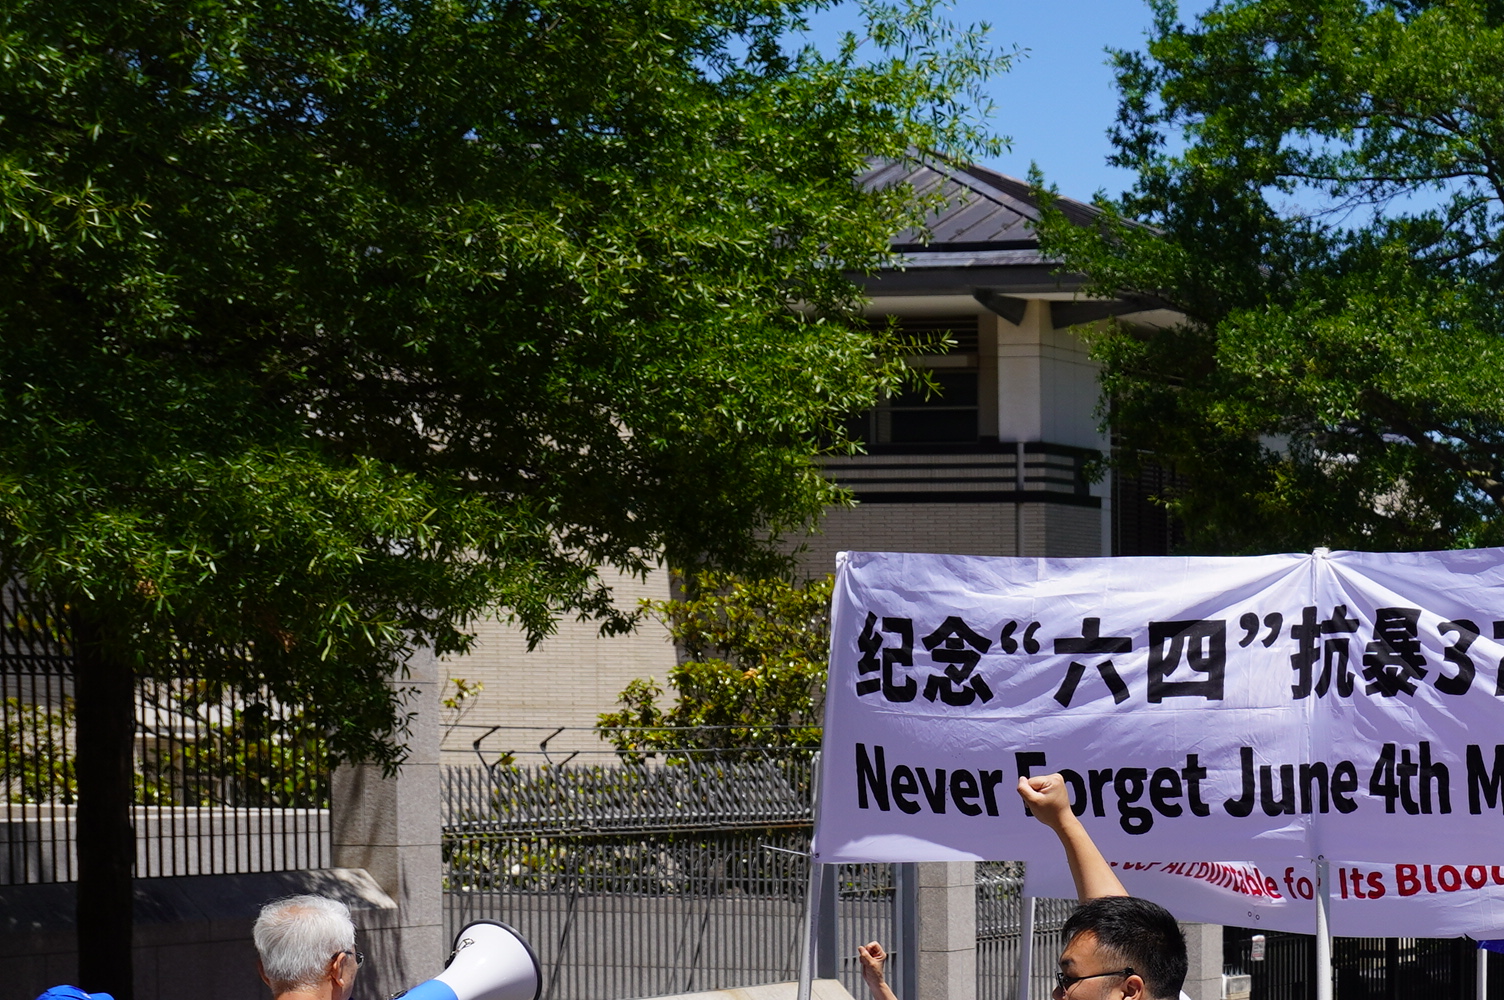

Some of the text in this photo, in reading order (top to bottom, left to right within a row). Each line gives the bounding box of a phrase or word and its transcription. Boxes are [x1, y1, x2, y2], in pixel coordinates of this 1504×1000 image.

[856, 743, 1002, 817] Never
[1015, 751, 1210, 835] Forget
[1223, 747, 1358, 816] June
[1369, 741, 1452, 815] 4th
[1283, 866, 1320, 900] fo
[1338, 867, 1386, 900] Its
